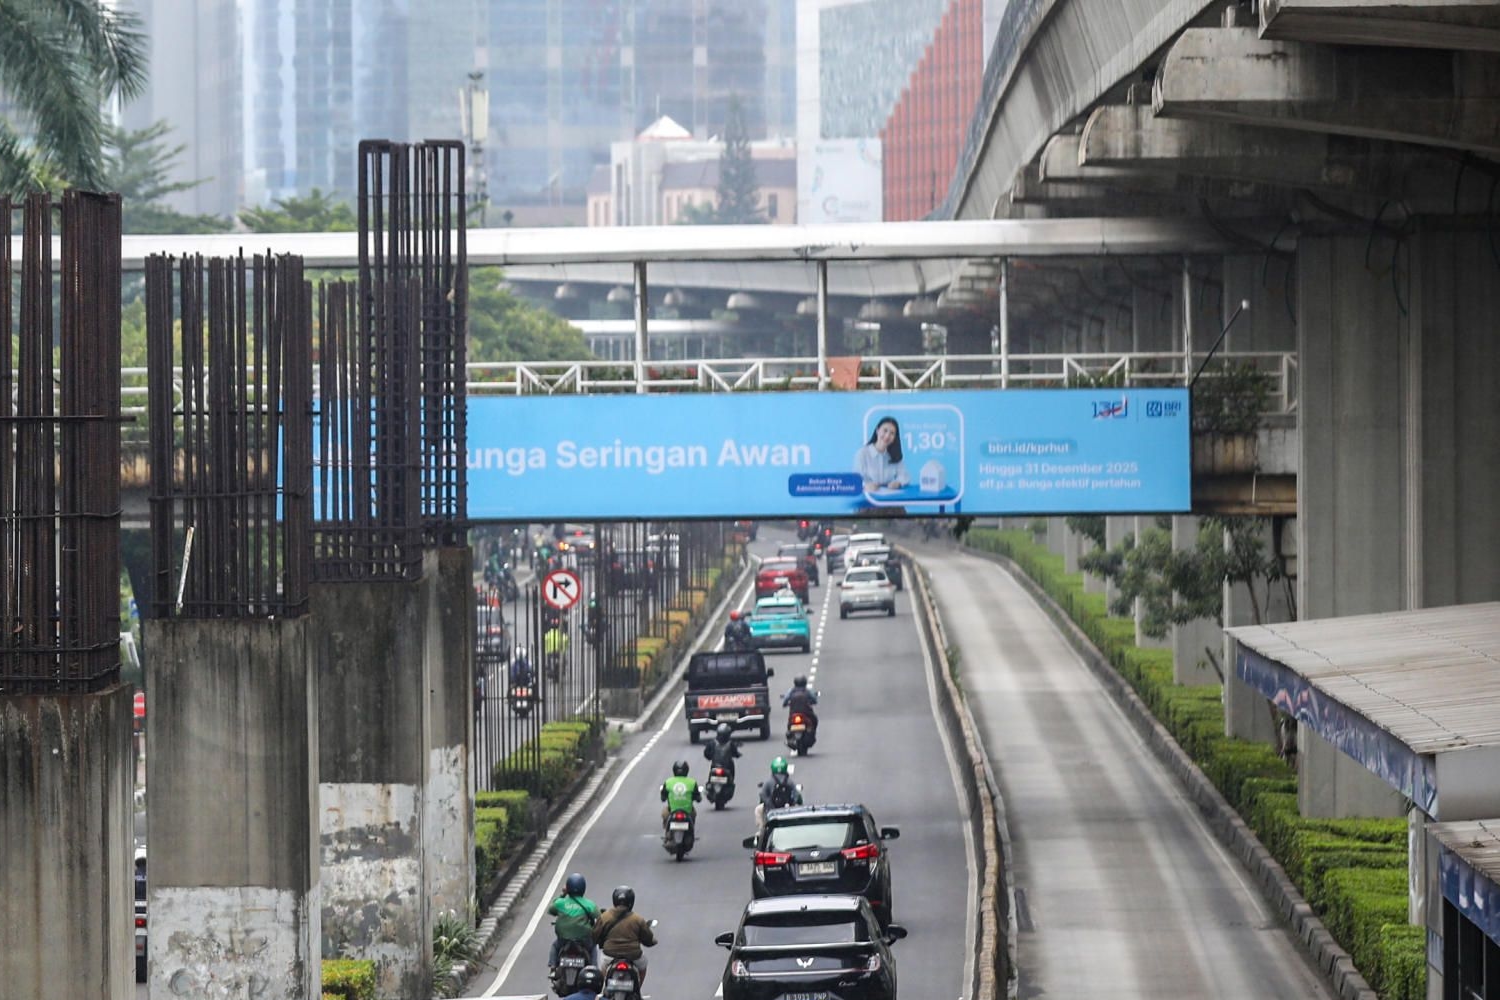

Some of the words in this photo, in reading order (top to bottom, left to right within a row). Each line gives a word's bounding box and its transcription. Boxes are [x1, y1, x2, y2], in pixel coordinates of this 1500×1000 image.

[465, 447, 546, 476] unga
[556, 439, 708, 475] Seringan
[717, 439, 812, 467] Awan
[980, 463, 1023, 476] Hingga
[1042, 462, 1103, 474] Desember
